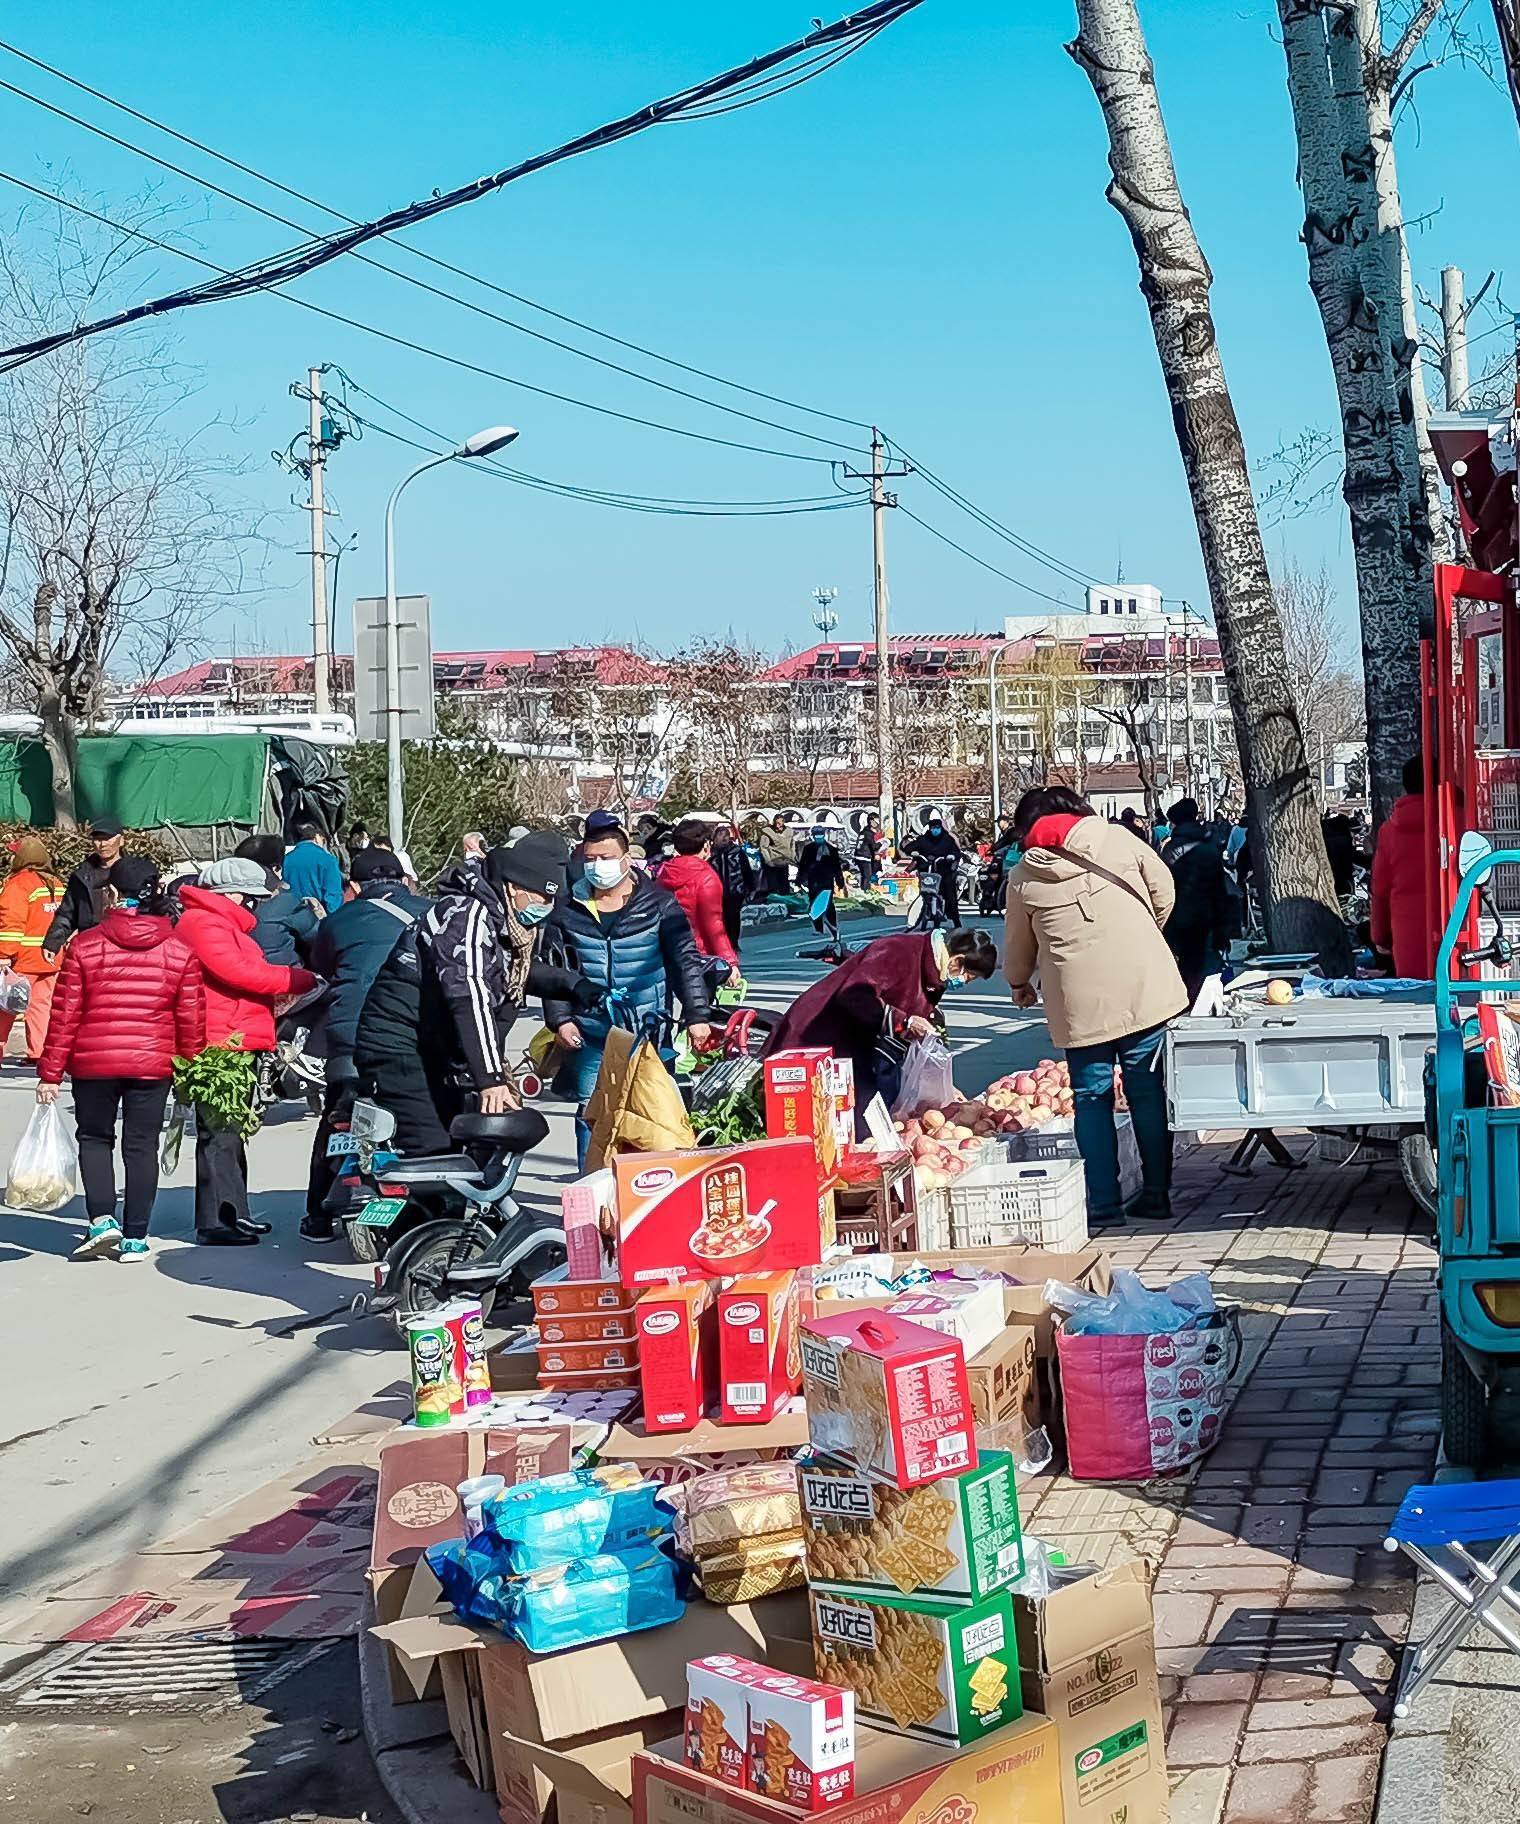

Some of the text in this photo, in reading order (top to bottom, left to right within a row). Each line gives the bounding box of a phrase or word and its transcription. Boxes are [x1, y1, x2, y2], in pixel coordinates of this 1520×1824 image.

[1177, 1373, 1207, 1391] cook
[806, 1478, 871, 1512] 好吃点
[818, 1603, 873, 1641] 好吃点
